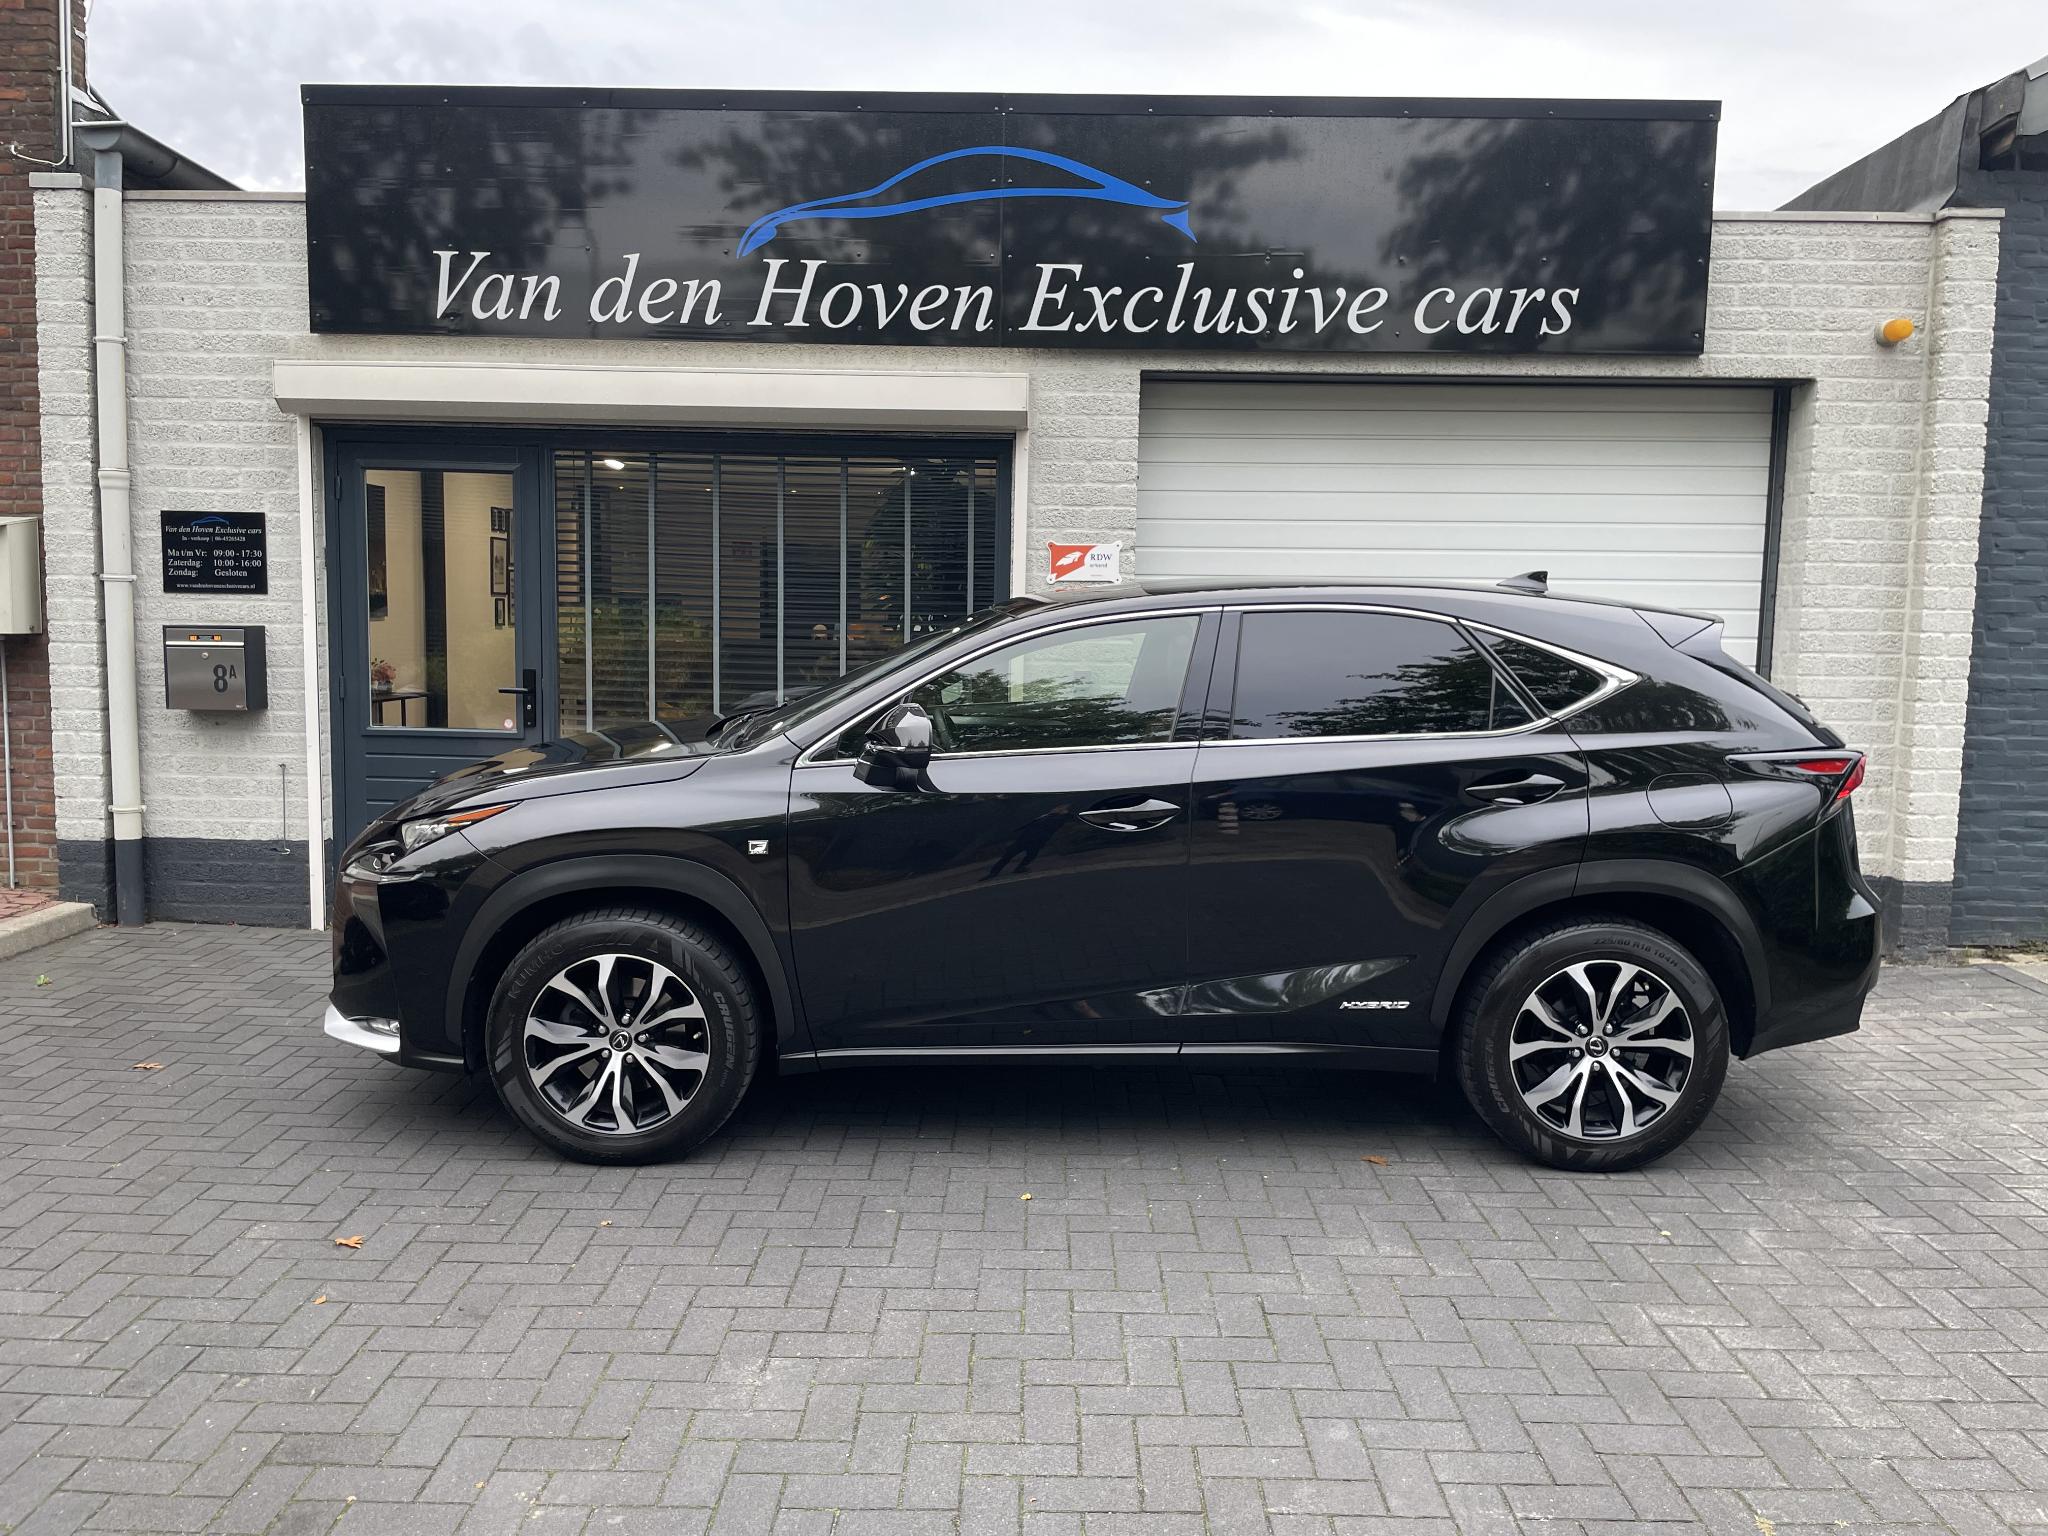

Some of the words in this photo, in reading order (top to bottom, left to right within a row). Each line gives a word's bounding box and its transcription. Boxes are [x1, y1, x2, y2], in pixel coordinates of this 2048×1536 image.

[431, 250, 562, 321] Van
[589, 252, 723, 325] den
[747, 258, 994, 332] Hoven
[1018, 261, 1389, 335] Exclusive
[1413, 285, 1581, 336] cars
[165, 525, 178, 533] Van
[179, 525, 191, 533] den
[192, 525, 214, 533] Hoven
[215, 526, 247, 534] Exclusive
[167, 549, 180, 557] Ma
[181, 549, 194, 557] t/m
[195, 549, 208, 557] Vr:
[213, 549, 235, 558] 09:00
[241, 549, 263, 558] 17:30
[1090, 553, 1113, 561] RDW
[168, 559, 203, 568] Zaterdag:
[213, 559, 235, 567] 10:00
[241, 559, 262, 567] 16:00
[168, 568, 199, 578] Zondag:
[214, 568, 248, 577] Gesloten
[1339, 1001, 1410, 1010] HYBRID
